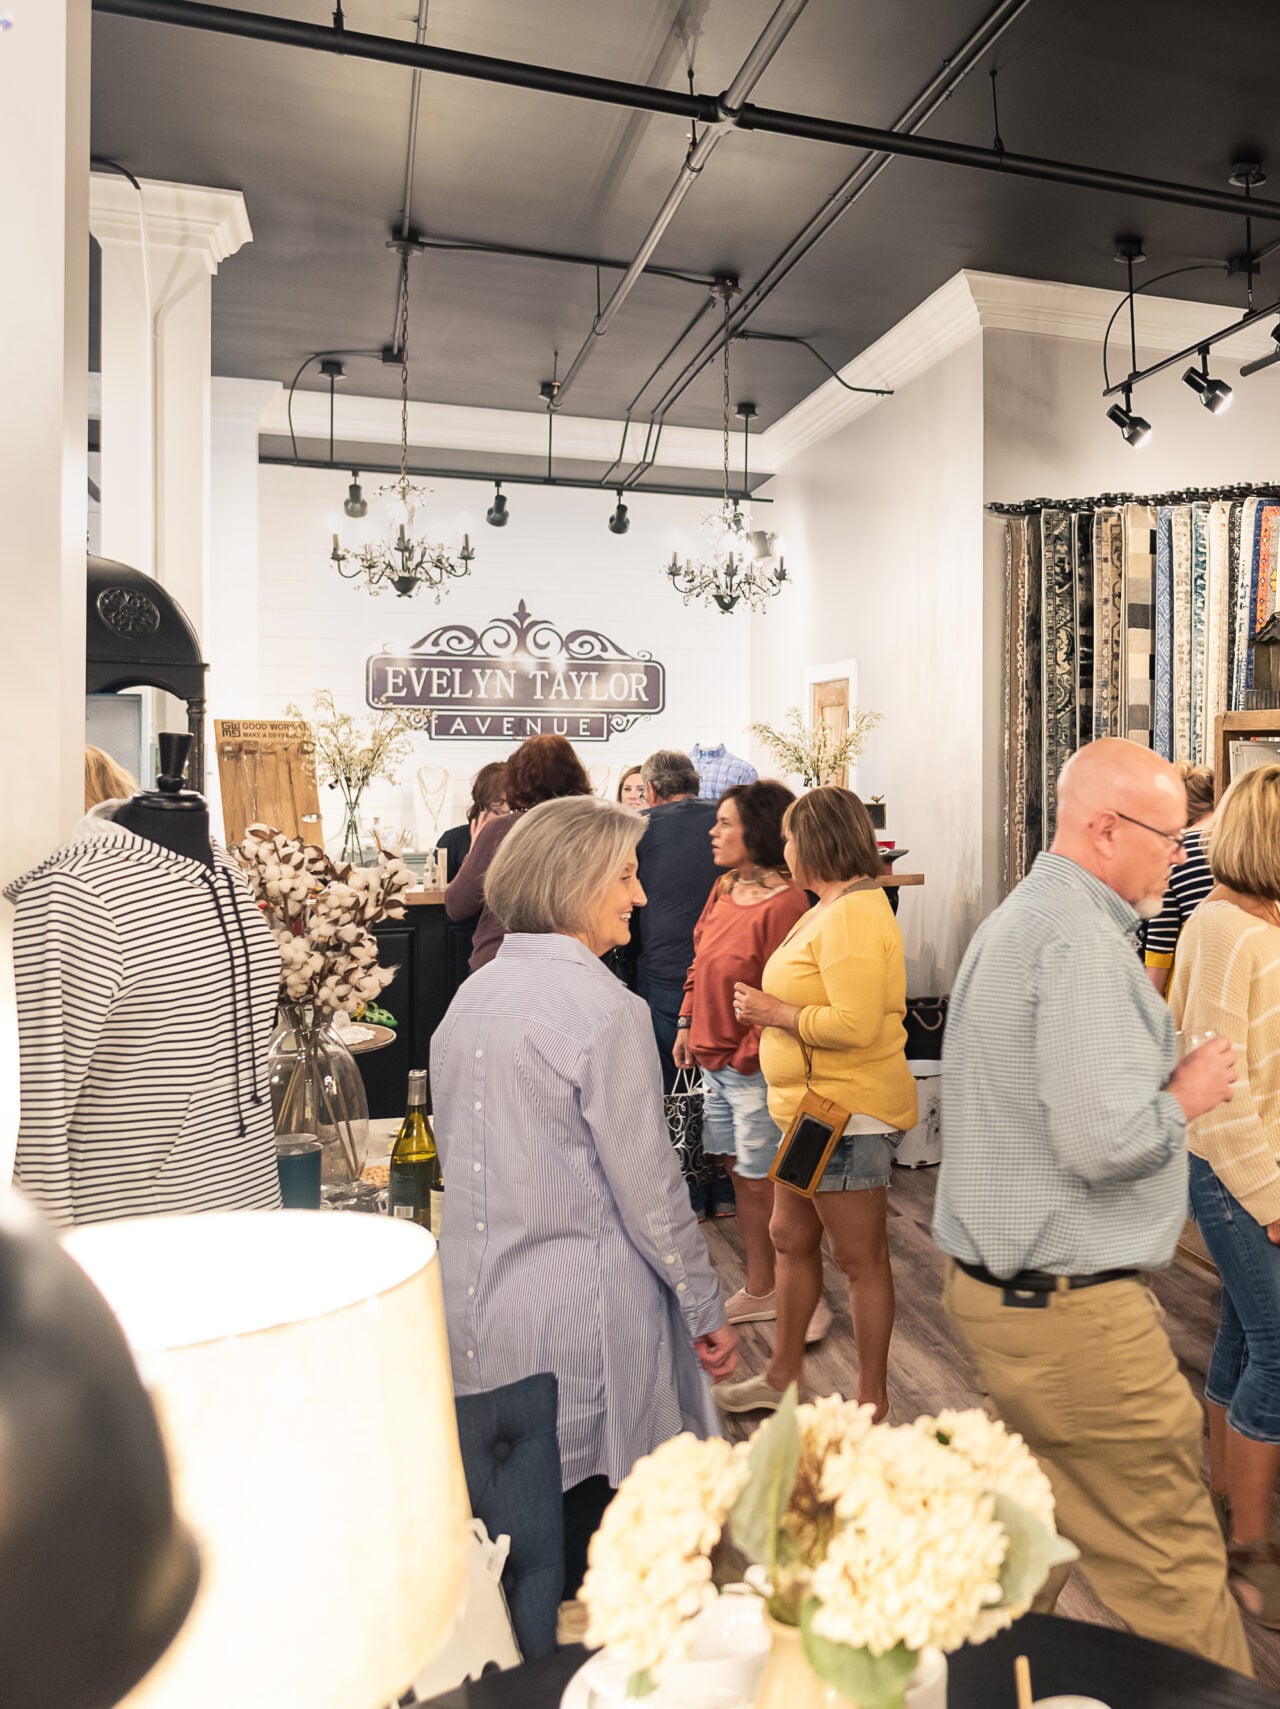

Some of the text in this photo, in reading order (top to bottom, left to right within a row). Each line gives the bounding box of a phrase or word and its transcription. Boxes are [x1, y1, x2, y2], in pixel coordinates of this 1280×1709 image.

[385, 666, 650, 702] EVELYN TAYLOR
[242, 722, 267, 730] GOOD
[449, 716, 591, 736] AVENUE
